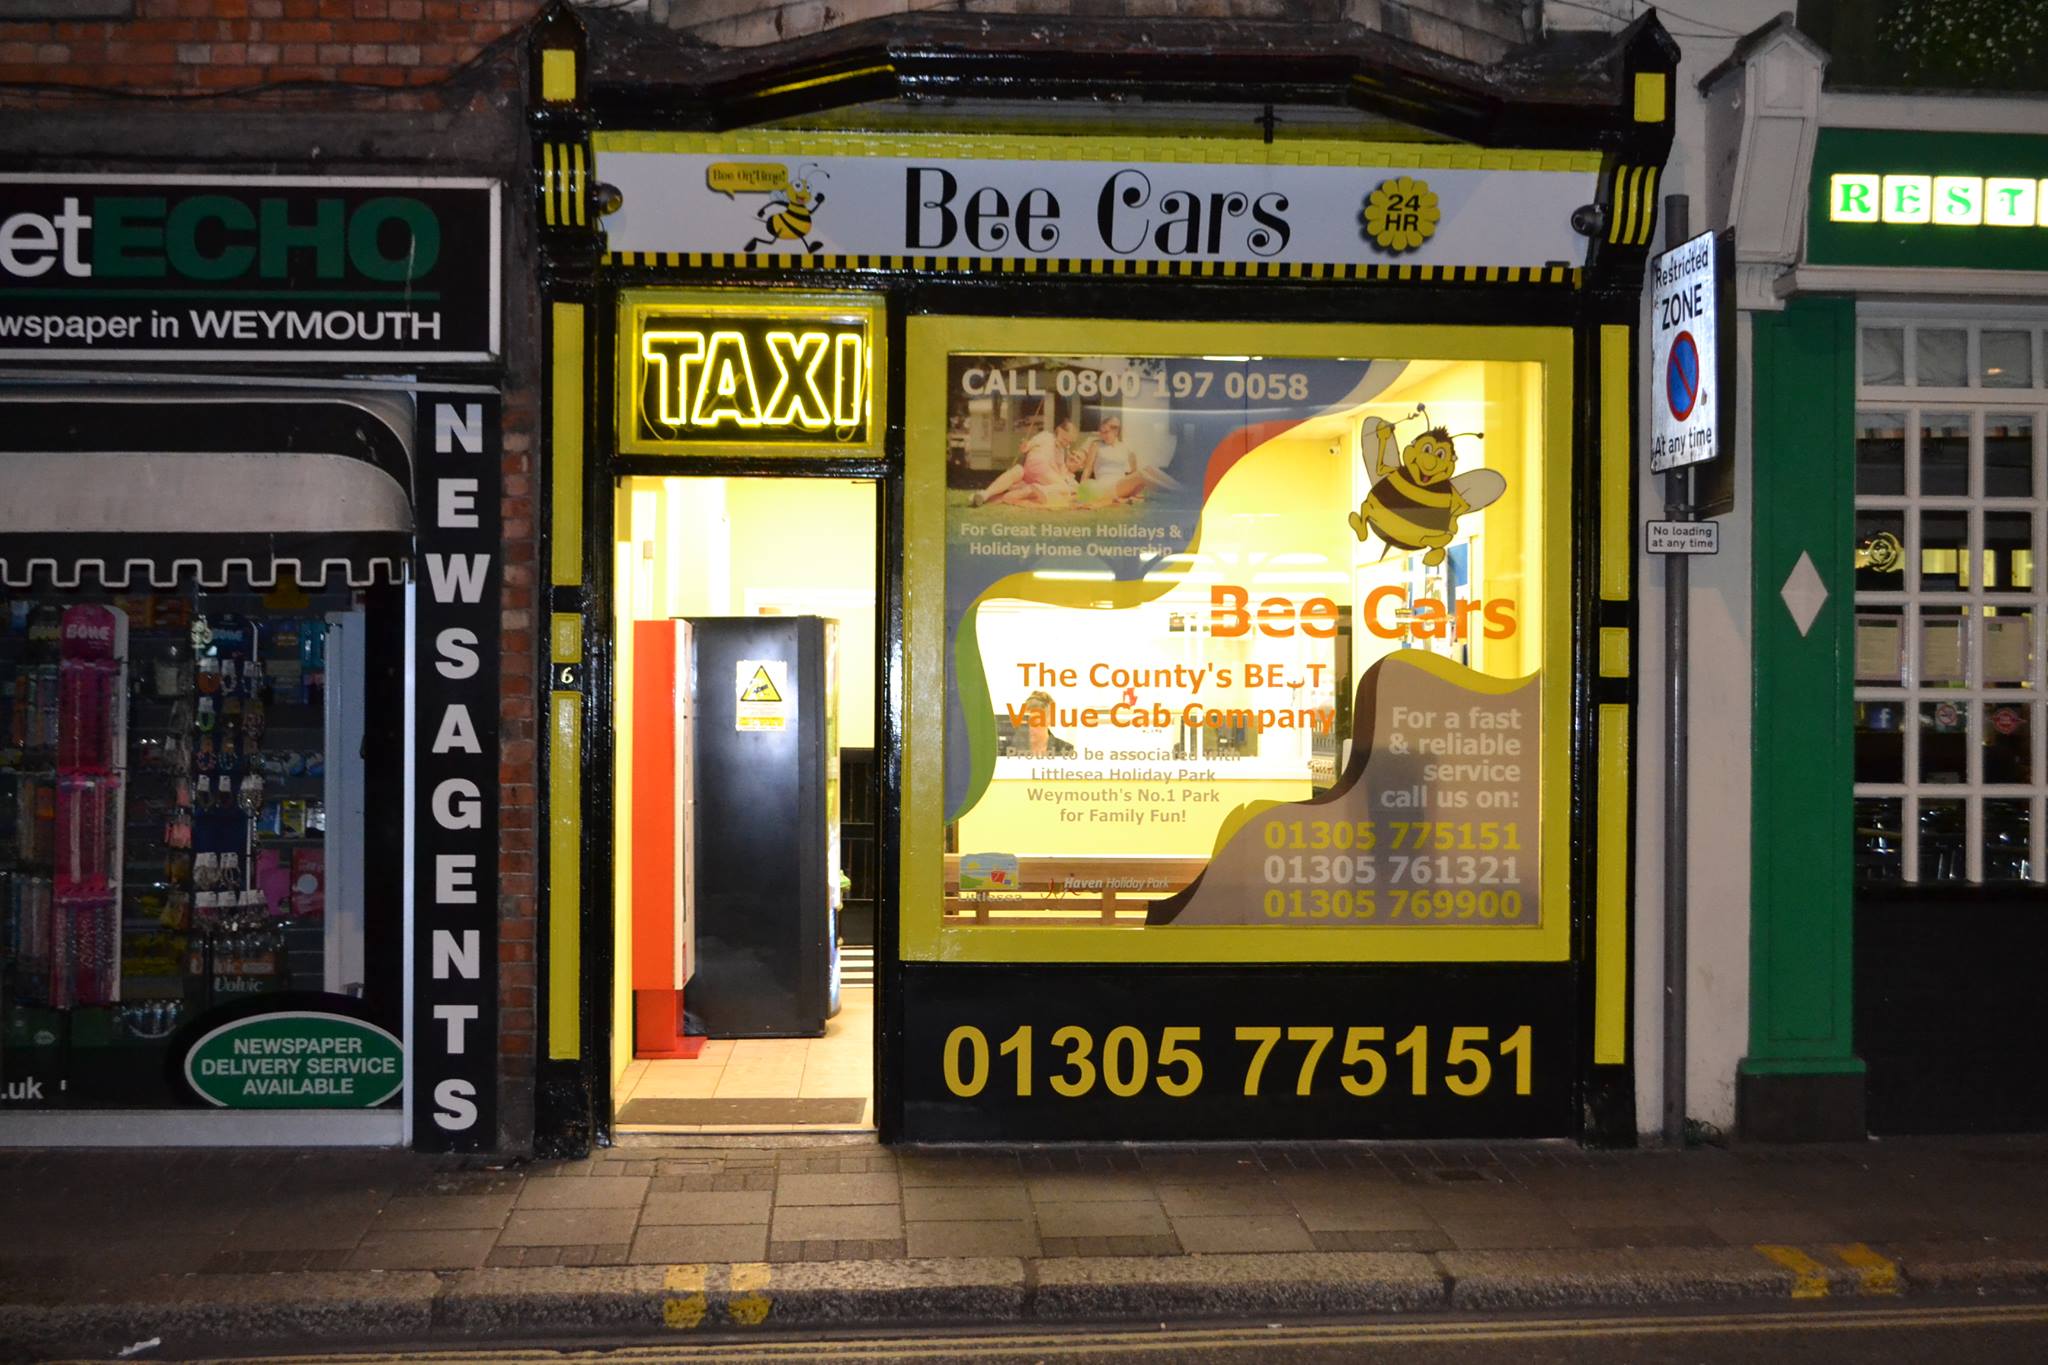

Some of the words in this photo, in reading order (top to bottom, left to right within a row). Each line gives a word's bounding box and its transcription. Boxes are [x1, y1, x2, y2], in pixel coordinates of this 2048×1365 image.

[905, 166, 1061, 252] Bee
[1096, 169, 1291, 256] Cars
[1388, 193, 1420, 211] 24
[1839, 183, 2024, 216] REST
[1384, 214, 1418, 232] HR
[1655, 245, 1709, 289] Restricted
[1662, 284, 1702, 330] ZONE
[0, 311, 141, 344] wspaper
[151, 309, 179, 338] in
[189, 310, 441, 340] WEYMOUTH
[641, 331, 863, 426] TAXI
[961, 369, 1046, 397] CALL
[1056, 370, 1141, 397] 0800
[1155, 371, 1214, 399] 197
[1224, 372, 1309, 400] 0058
[1655, 436, 1666, 458] At
[1668, 435, 1686, 456] any
[1689, 427, 1712, 449] time
[960, 523, 987, 537] For
[992, 523, 1036, 538] Great
[1041, 523, 1092, 538] Haven
[1096, 523, 1165, 541] Holidays
[1169, 524, 1182, 538] &
[1653, 525, 1668, 536] No
[1672, 525, 1712, 539] loading
[970, 543, 1030, 559] Holiday
[1035, 543, 1083, 557] Home
[1087, 543, 1173, 560] Ownership
[1652, 538, 1663, 548] at
[1667, 540, 1685, 550] any
[1689, 538, 1713, 549] time
[1210, 585, 1338, 638] Bee
[1363, 585, 1517, 640] Cars
[560, 667, 574, 684] 6
[1017, 663, 1077, 688] The
[1089, 662, 1233, 694] County's
[1006, 703, 1099, 728] Value
[1110, 703, 1171, 728] Cab
[1184, 703, 1336, 736] Company
[1392, 706, 1435, 729] For
[1444, 711, 1460, 729] a
[1468, 706, 1522, 730] fast
[1006, 747, 1059, 761] Proud
[1062, 749, 1078, 761] to
[1084, 746, 1105, 761] be
[1109, 746, 1198, 761] associated
[1389, 733, 1410, 755] &
[1418, 733, 1521, 756] reliable
[425, 403, 492, 1131] NEWSAGENTS
[1031, 768, 1103, 782] Littlesea
[1110, 768, 1172, 785] Holiday
[1178, 769, 1216, 783] Park
[1423, 760, 1521, 782] service
[1027, 788, 1133, 805] Weymouth's
[1138, 788, 1176, 802] No.1
[1182, 788, 1220, 803] Park
[1380, 785, 1428, 808] call
[1437, 790, 1469, 808] us
[1476, 790, 1520, 808] on:
[1060, 808, 1085, 822] for
[1089, 808, 1145, 826] Family
[1150, 809, 1186, 823] Fun!
[1264, 820, 1377, 849] 01305
[1389, 821, 1521, 850] 775151
[1264, 855, 1376, 884] 01305
[1388, 856, 1521, 885] 761321
[1063, 876, 1104, 889] Haven
[1105, 876, 1144, 891] Holiday
[1146, 877, 1169, 889] Park
[1264, 889, 1376, 918] 01305
[1388, 889, 1521, 919] 769900
[233, 1037, 362, 1055] NEWSPAPER
[201, 1058, 301, 1076] DELIVERY
[306, 1057, 395, 1075] SERVICE
[943, 1025, 1204, 1097] 01305
[1234, 1024, 1532, 1096] 775151
[243, 1078, 354, 1096] AVAILABLE
